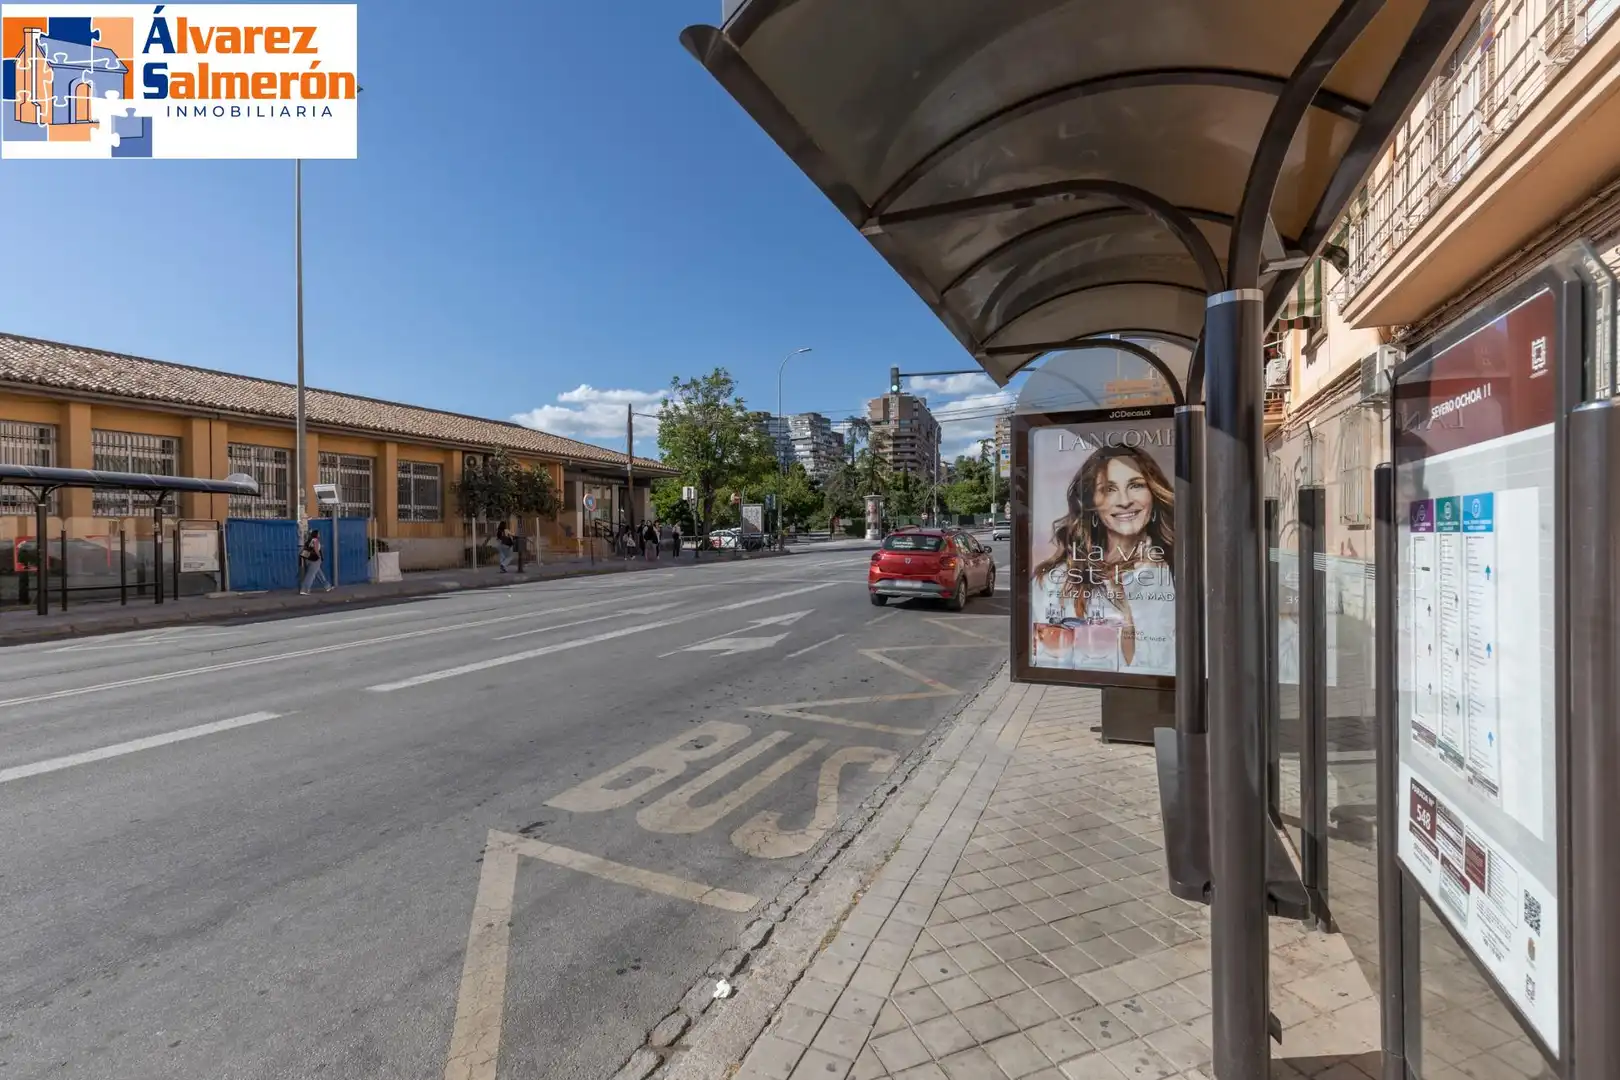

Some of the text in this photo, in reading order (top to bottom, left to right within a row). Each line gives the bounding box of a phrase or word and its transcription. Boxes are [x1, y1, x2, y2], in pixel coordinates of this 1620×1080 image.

[1431, 400, 1455, 419] SEVERO
[1455, 387, 1481, 409] OCHOA
[1109, 409, 1152, 419] JCDecaux
[1072, 541, 1165, 562] La vie
[1048, 566, 1104, 585] est
[1048, 589, 1080, 599] FELIZ
[1107, 590, 1124, 599] DE
[1128, 591, 1144, 600] LA
[542, 720, 900, 859] BUS
